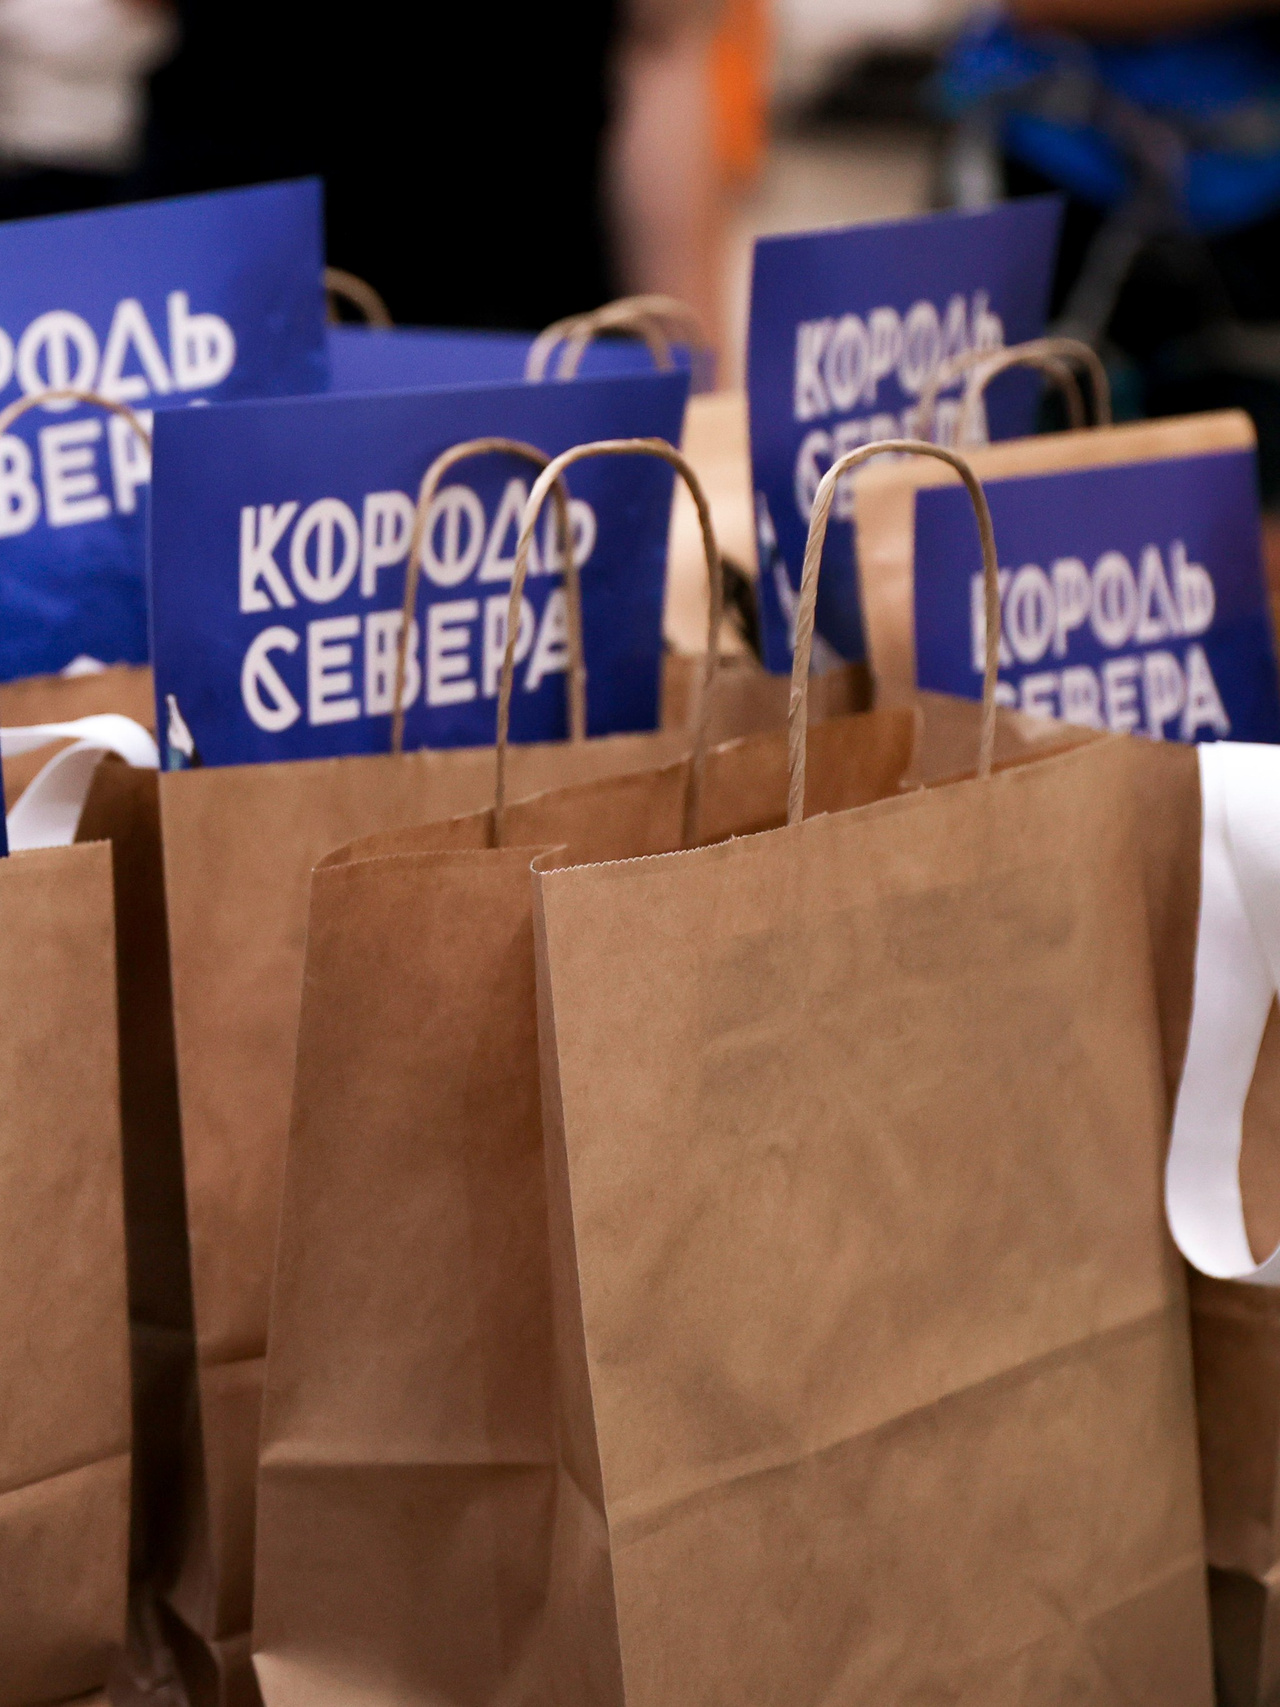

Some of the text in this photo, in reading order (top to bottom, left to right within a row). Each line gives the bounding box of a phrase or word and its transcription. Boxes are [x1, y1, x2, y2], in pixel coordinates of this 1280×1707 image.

[239, 478, 597, 614] КОРОЛЬ
[972, 538, 1216, 674] КОРОЛЬ
[241, 588, 580, 732] СЕВЕРА
